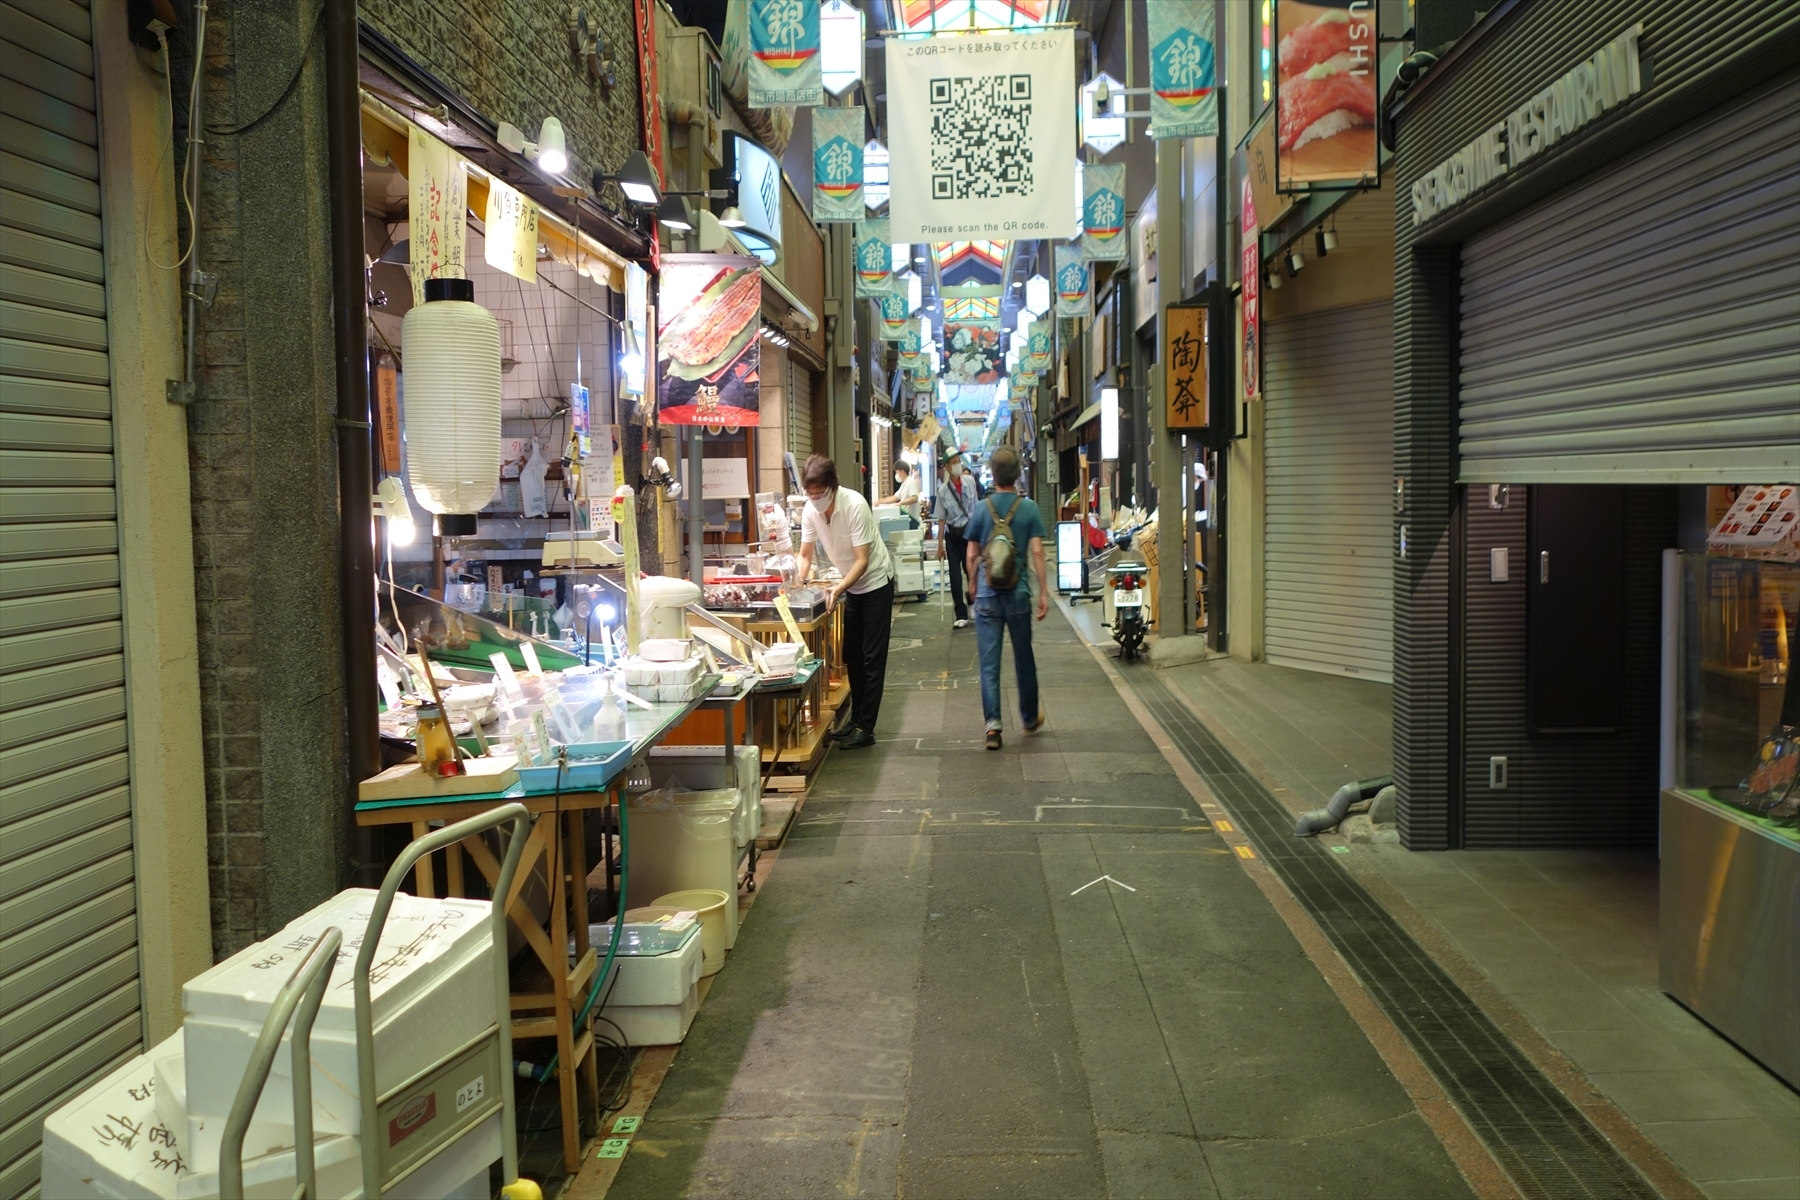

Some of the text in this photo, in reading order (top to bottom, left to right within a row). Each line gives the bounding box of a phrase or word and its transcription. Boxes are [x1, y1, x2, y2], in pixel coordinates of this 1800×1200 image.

[763, 46, 791, 57] NISHIKI
[906, 39, 1058, 57] このQRコードを読み取ってください
[1160, 34, 1203, 96] 錦
[1507, 22, 1644, 169] RESTAURANT
[820, 141, 853, 189] 錦
[921, 220, 1049, 234] Please scan the QR code.
[1088, 192, 1116, 232] 錦
